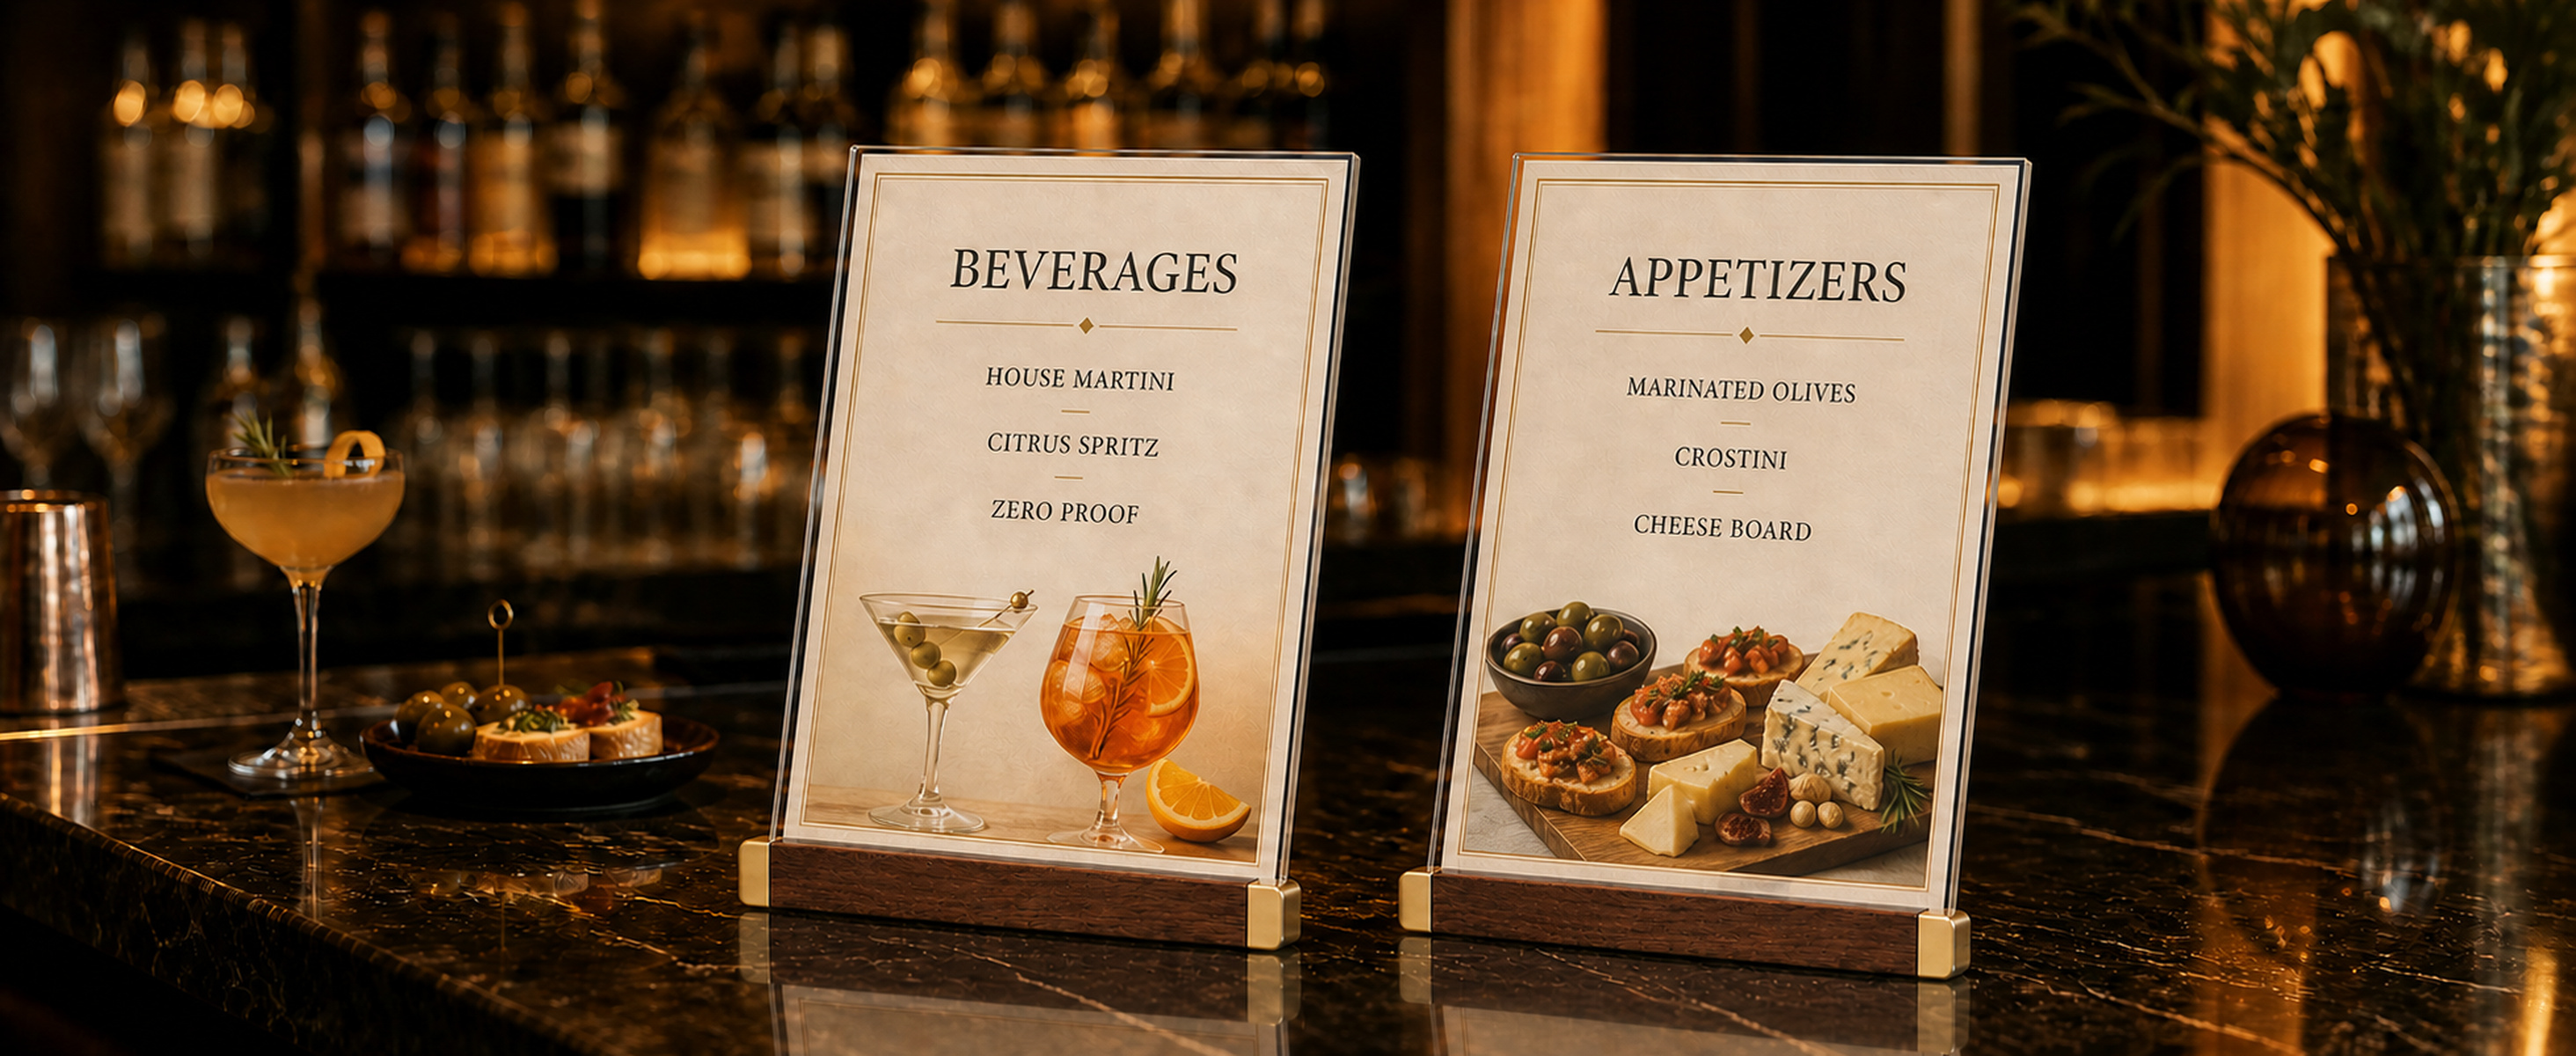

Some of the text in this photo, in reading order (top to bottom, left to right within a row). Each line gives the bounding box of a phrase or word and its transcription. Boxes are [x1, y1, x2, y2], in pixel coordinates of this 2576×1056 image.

[950, 249, 1237, 295] BEVERAGES
[1609, 256, 1906, 303] APPETIZERS
[985, 367, 1175, 392] HOUSE MARTINI
[1627, 377, 1856, 404] MARINATED OLIVES
[987, 432, 1160, 458] CITRUS SPRITZ
[1675, 446, 1787, 470] CROSTINI
[991, 499, 1139, 524] ZERO PROOF
[1634, 514, 1812, 541] CHEESE BOARD
